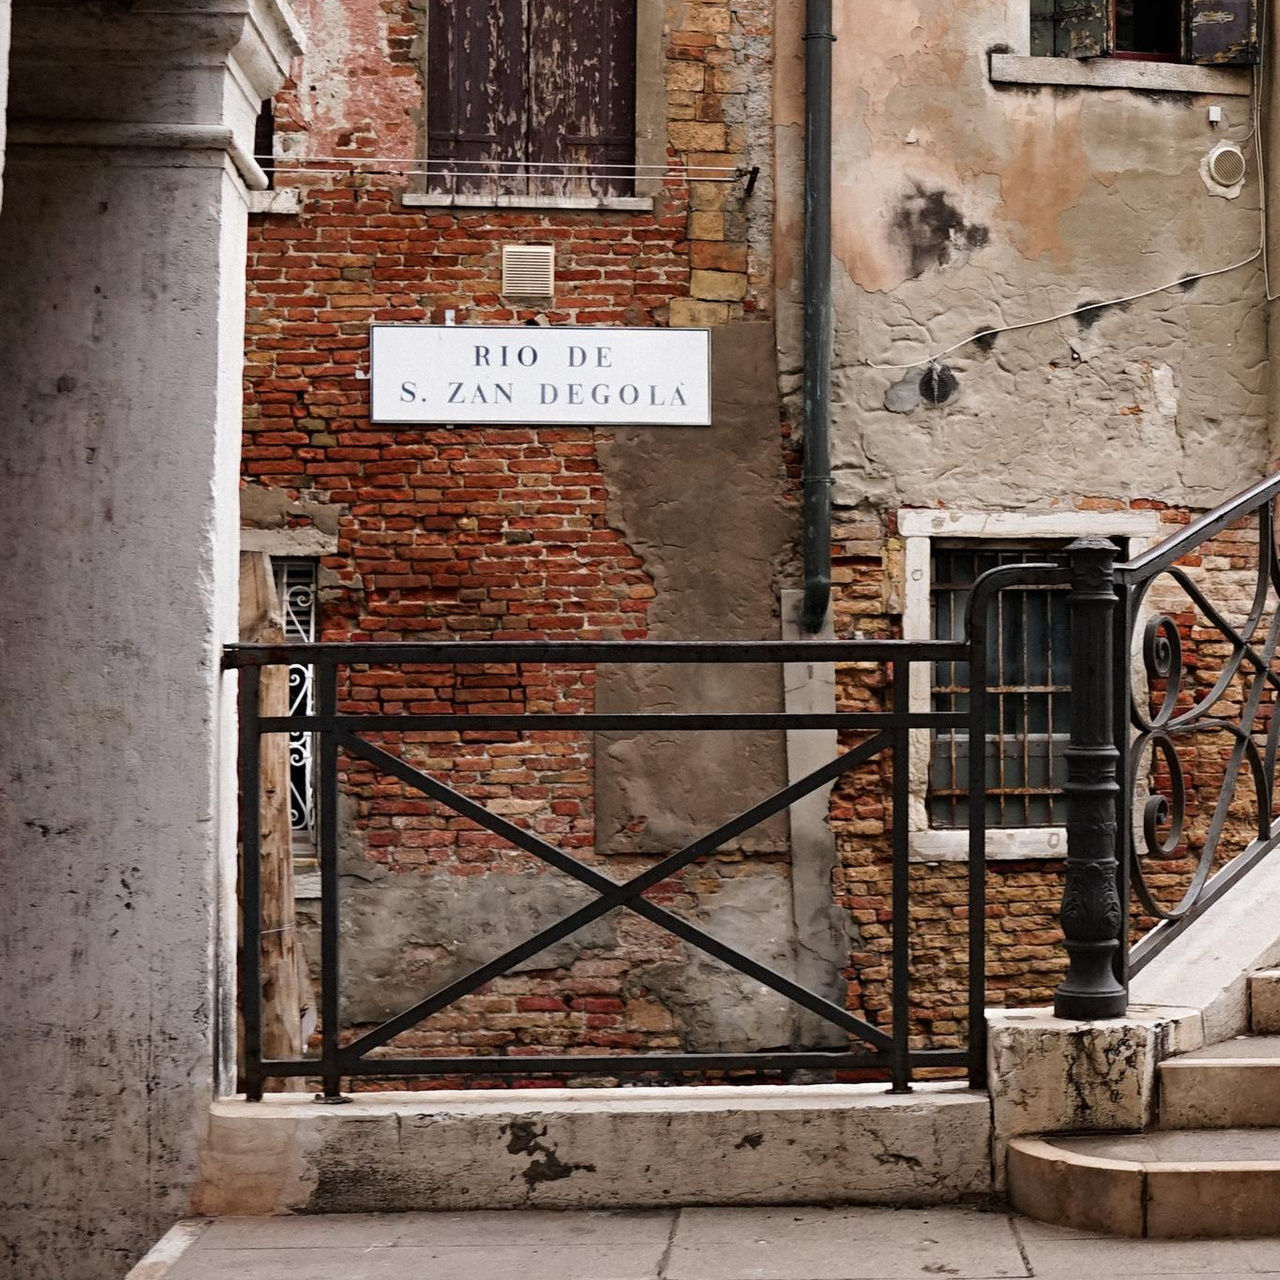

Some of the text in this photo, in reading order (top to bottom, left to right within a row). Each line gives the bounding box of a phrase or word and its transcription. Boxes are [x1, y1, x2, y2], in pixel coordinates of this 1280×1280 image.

[474, 346, 611, 367] RIO DE
[401, 382, 426, 402] S.
[448, 383, 512, 404] ZAN
